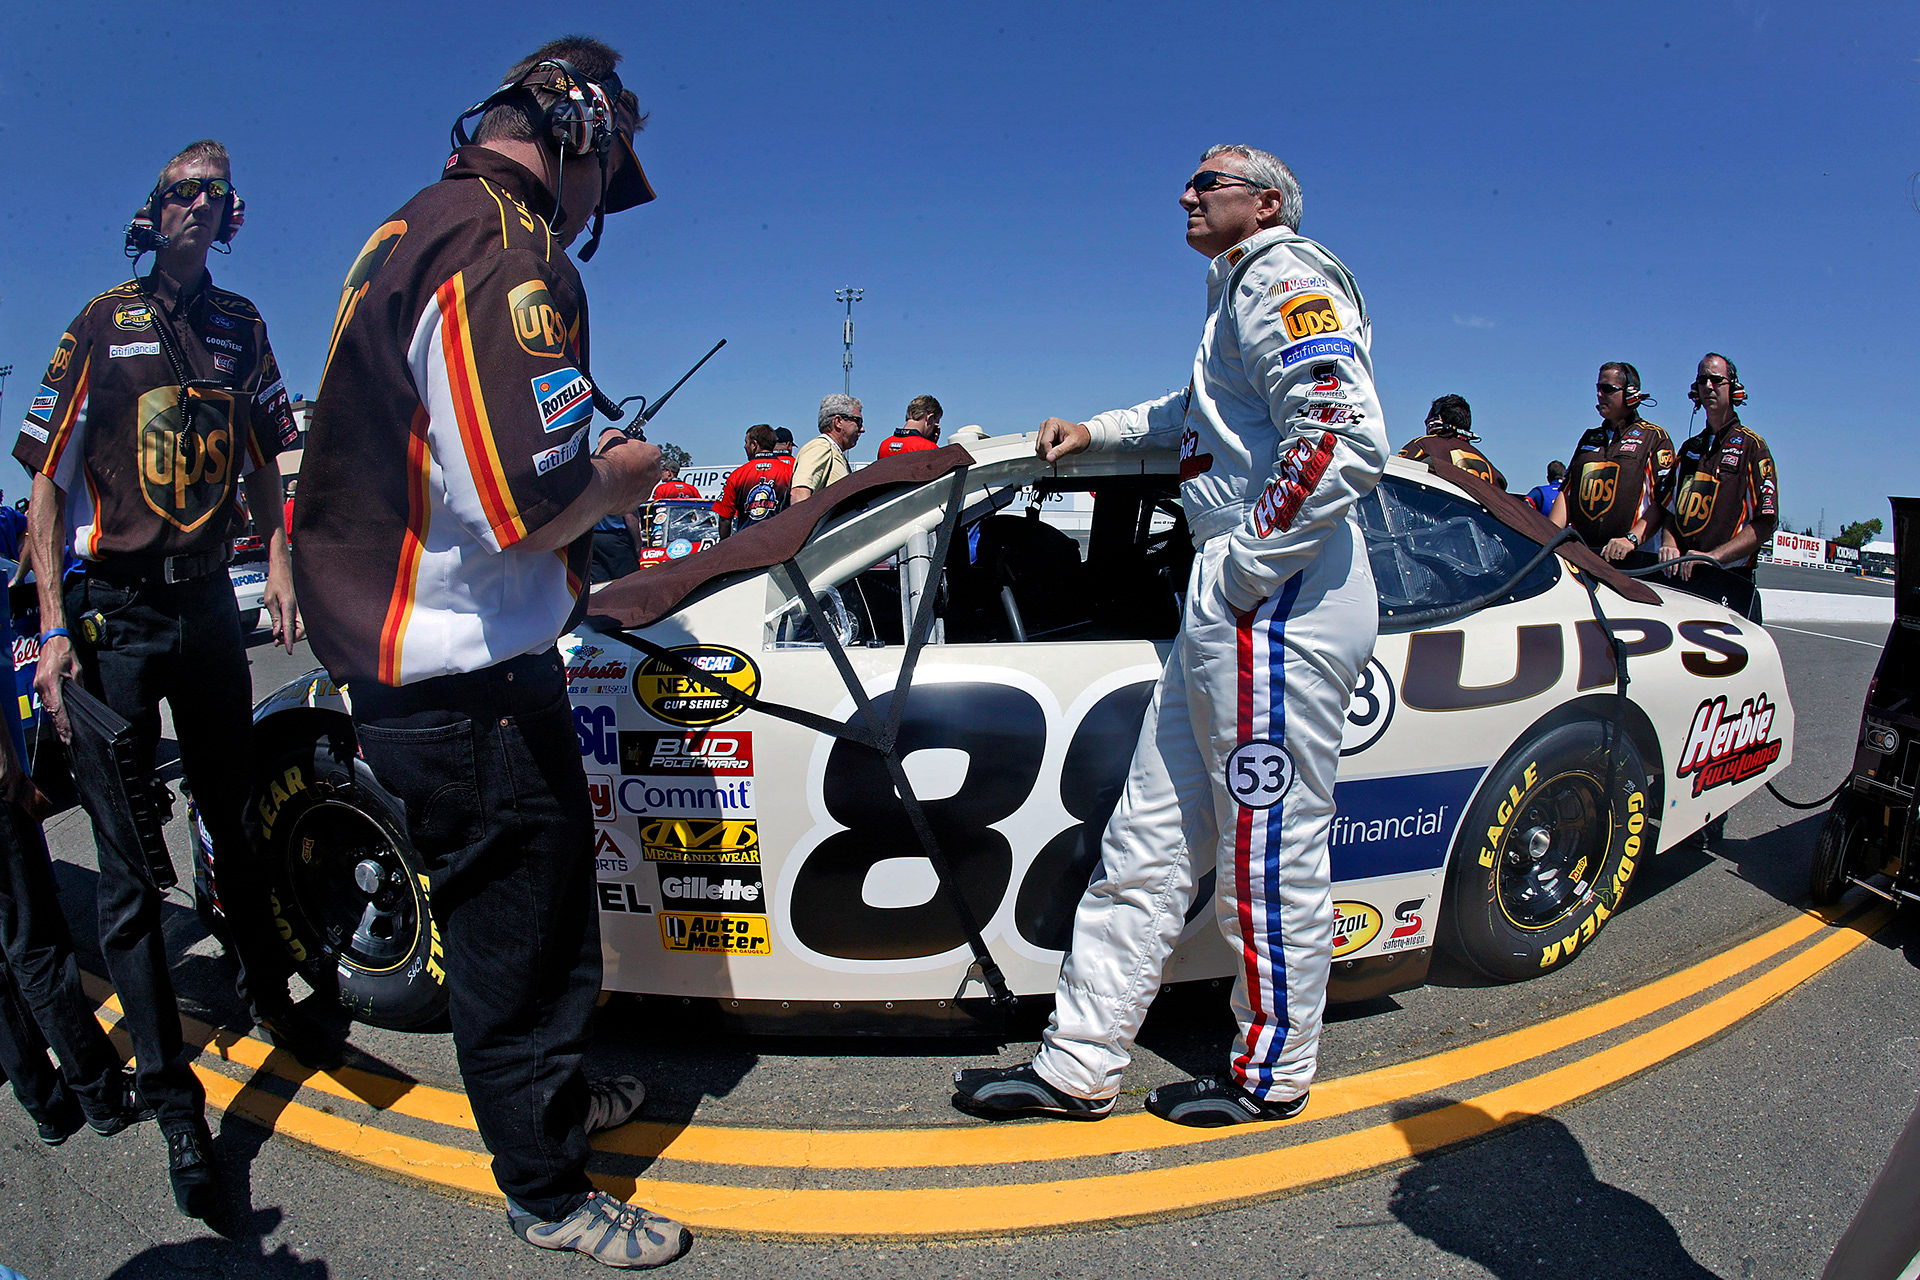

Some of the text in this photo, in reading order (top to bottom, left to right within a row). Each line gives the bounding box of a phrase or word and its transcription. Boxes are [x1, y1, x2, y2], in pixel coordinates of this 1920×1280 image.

[110, 342, 159, 357] citifinancial
[206, 336, 242, 352] GOODYEAR
[541, 381, 586, 418] ROTELLA
[146, 430, 228, 509] ups
[683, 472, 719, 487] CHIP
[1257, 441, 1312, 535] Herbie
[1582, 479, 1614, 511] ups
[1776, 535, 1820, 551] BIG O TIRES
[1400, 617, 1749, 712] UPS
[657, 676, 728, 694] NEXT
[664, 699, 729, 710] CUP SERIES
[653, 739, 739, 755] BUD
[1680, 697, 1774, 773] Herbie
[1235, 756, 1287, 796] 53
[1695, 742, 1781, 793] FULLY LOADED
[618, 779, 750, 814] Commit
[1478, 761, 1538, 869] EAGLE
[643, 846, 760, 863] MECHANIX WEAR
[662, 876, 760, 901] Gillette
[689, 918, 750, 934] Auto
[687, 933, 765, 950] Meter
